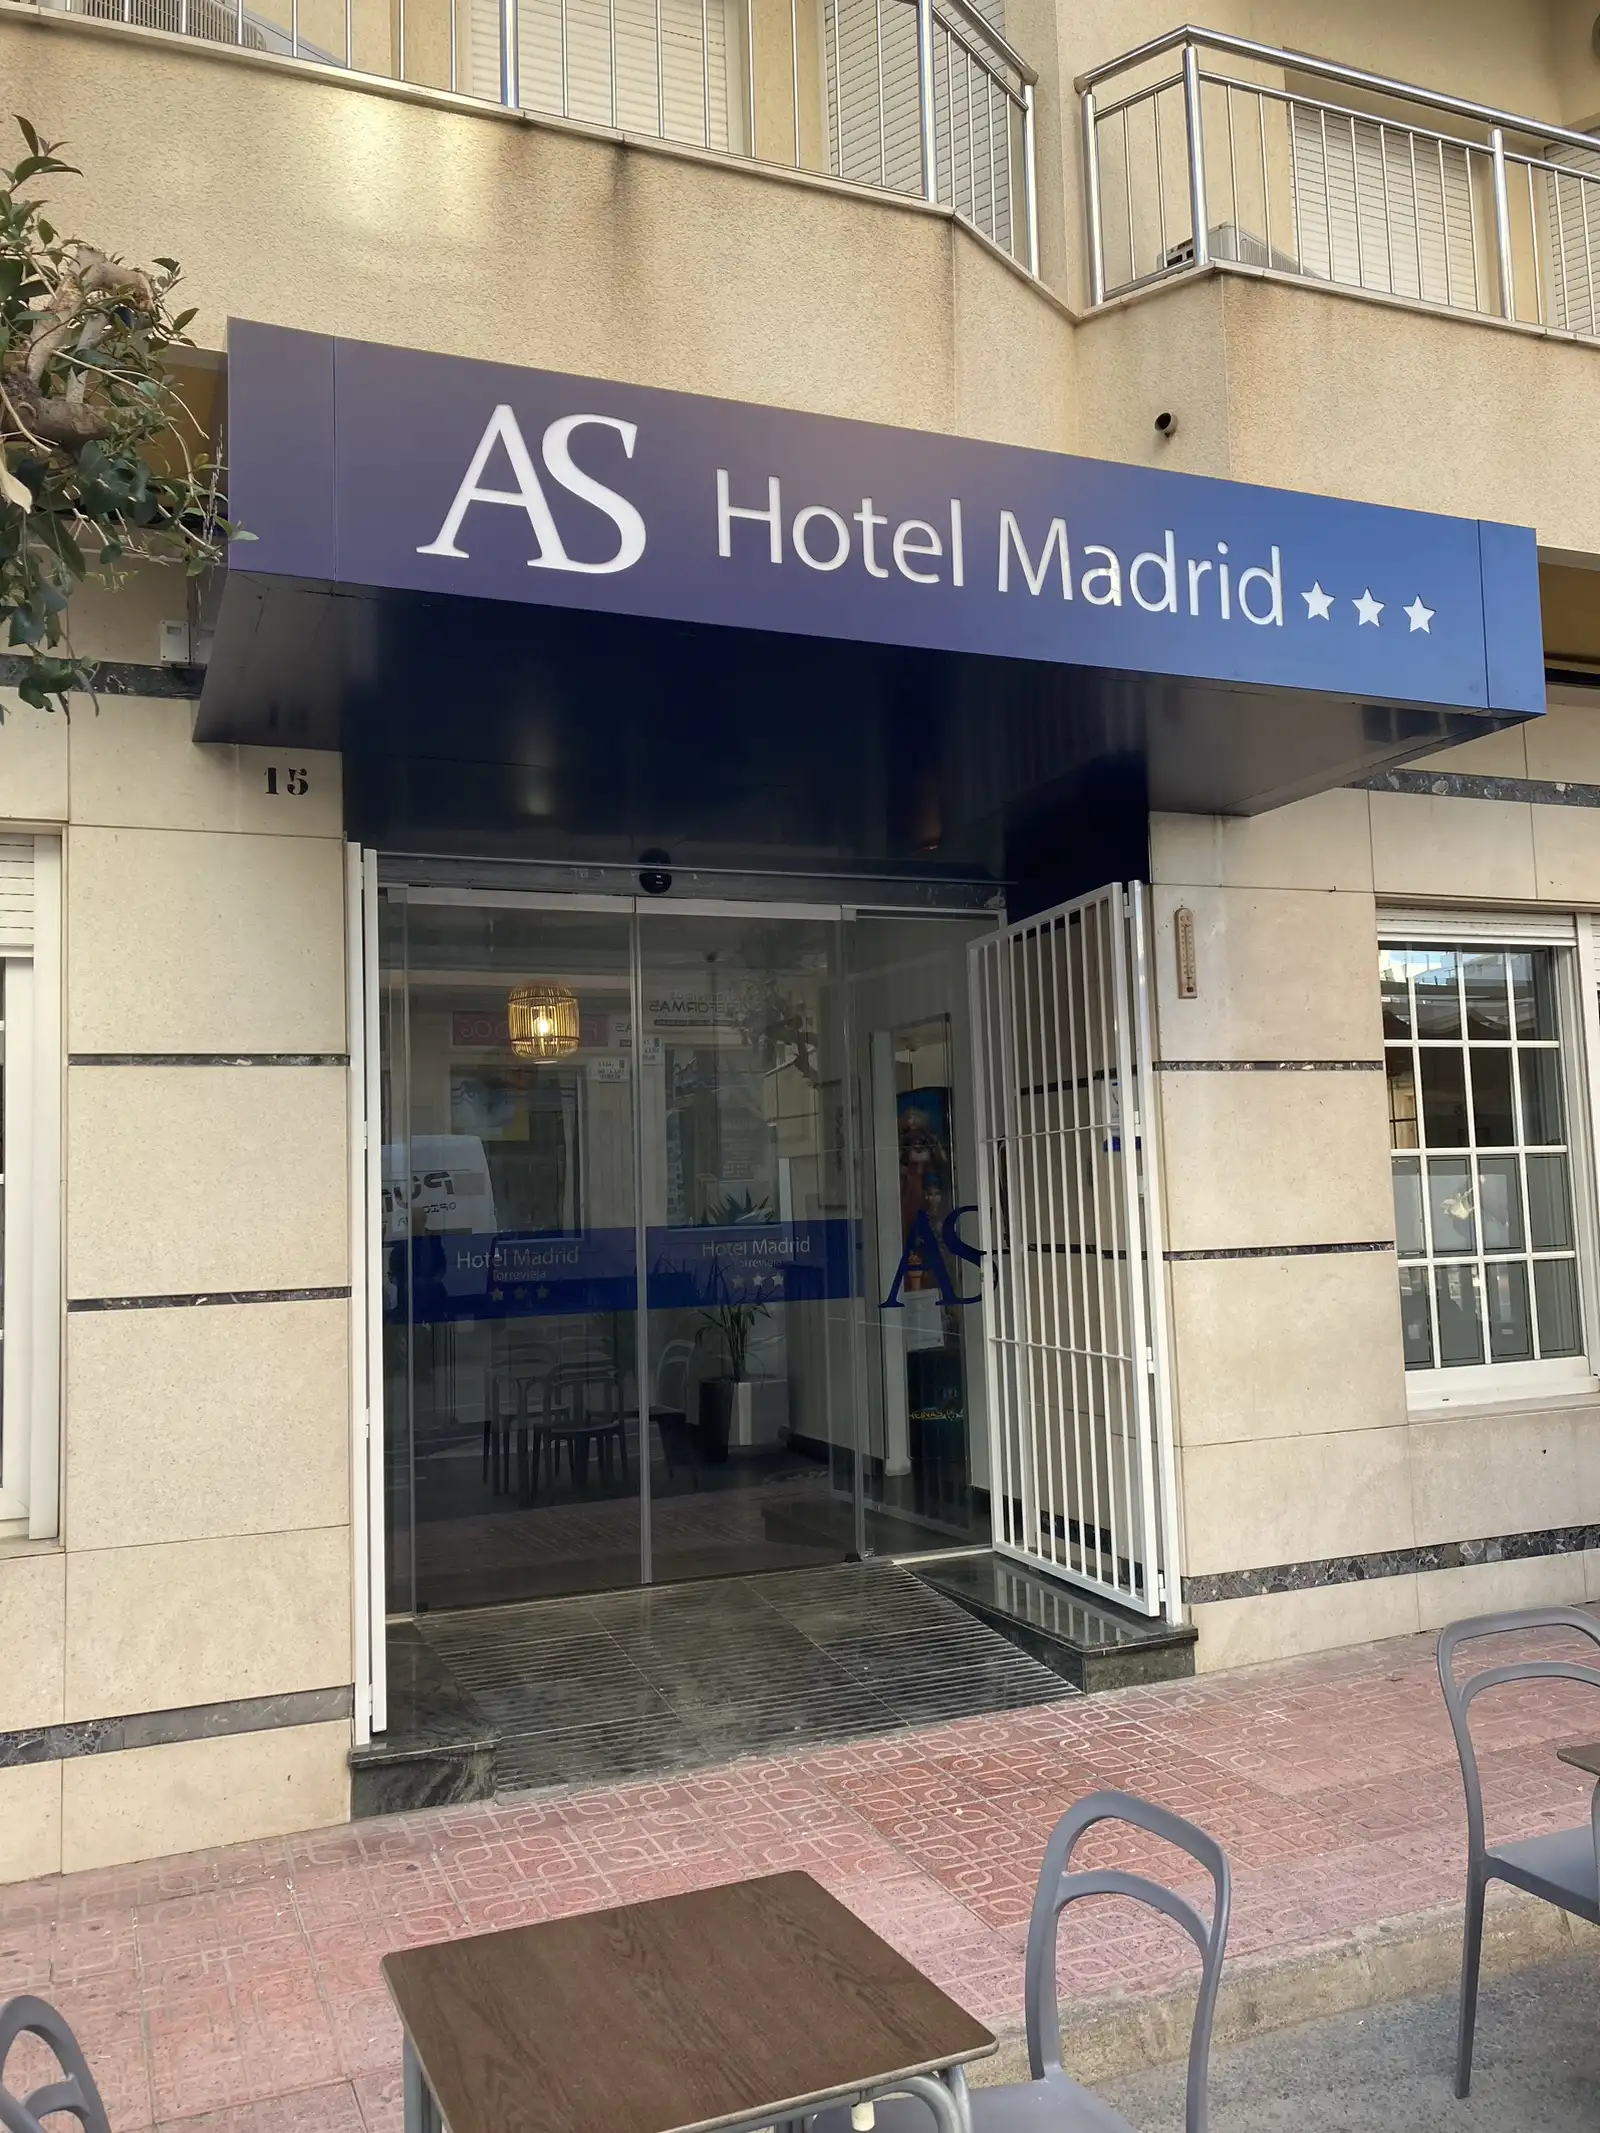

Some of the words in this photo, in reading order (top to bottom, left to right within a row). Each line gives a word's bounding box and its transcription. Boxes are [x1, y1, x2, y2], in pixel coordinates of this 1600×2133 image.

[416, 404, 647, 575] AS
[714, 467, 964, 588] Hotel
[997, 509, 1284, 628] Madrid
[263, 767, 309, 796] 15
[456, 1247, 507, 1269] Hotel
[513, 1245, 579, 1267] Madrid
[702, 1240, 747, 1258] Hotel
[752, 1235, 811, 1256] Madrid
[878, 1205, 998, 1309] AS
